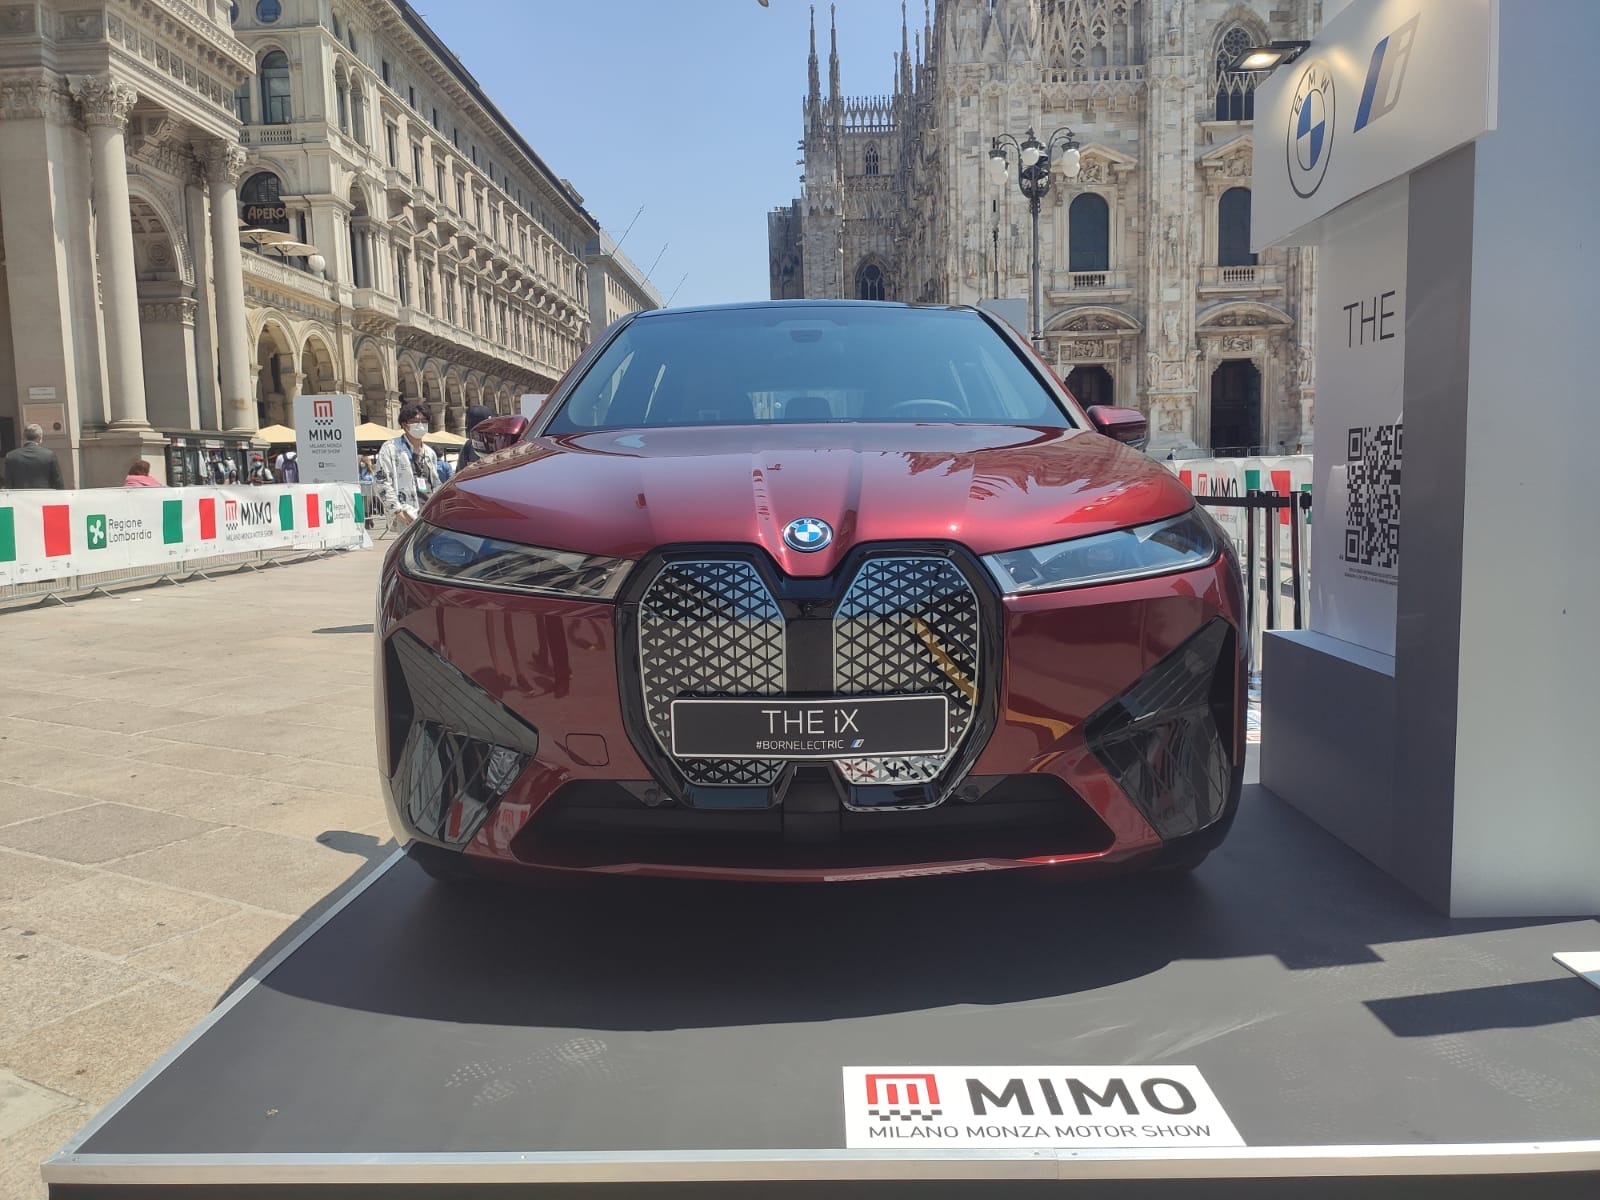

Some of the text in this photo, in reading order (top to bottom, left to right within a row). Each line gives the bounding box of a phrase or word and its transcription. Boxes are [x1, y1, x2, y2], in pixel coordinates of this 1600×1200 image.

[1294, 69, 1331, 115] BMW
[1343, 290, 1396, 348] THE
[309, 428, 342, 441] MIMO
[240, 501, 272, 526] MIMO
[109, 518, 142, 532] Regione
[109, 530, 152, 543] Lombardia
[761, 708, 860, 735] THE iX
[756, 739, 845, 750] #BORNELECTRIC
[965, 1077, 1197, 1116] MIMO
[869, 1125, 1211, 1139] MILANO MONZA MOTOR SHOW
